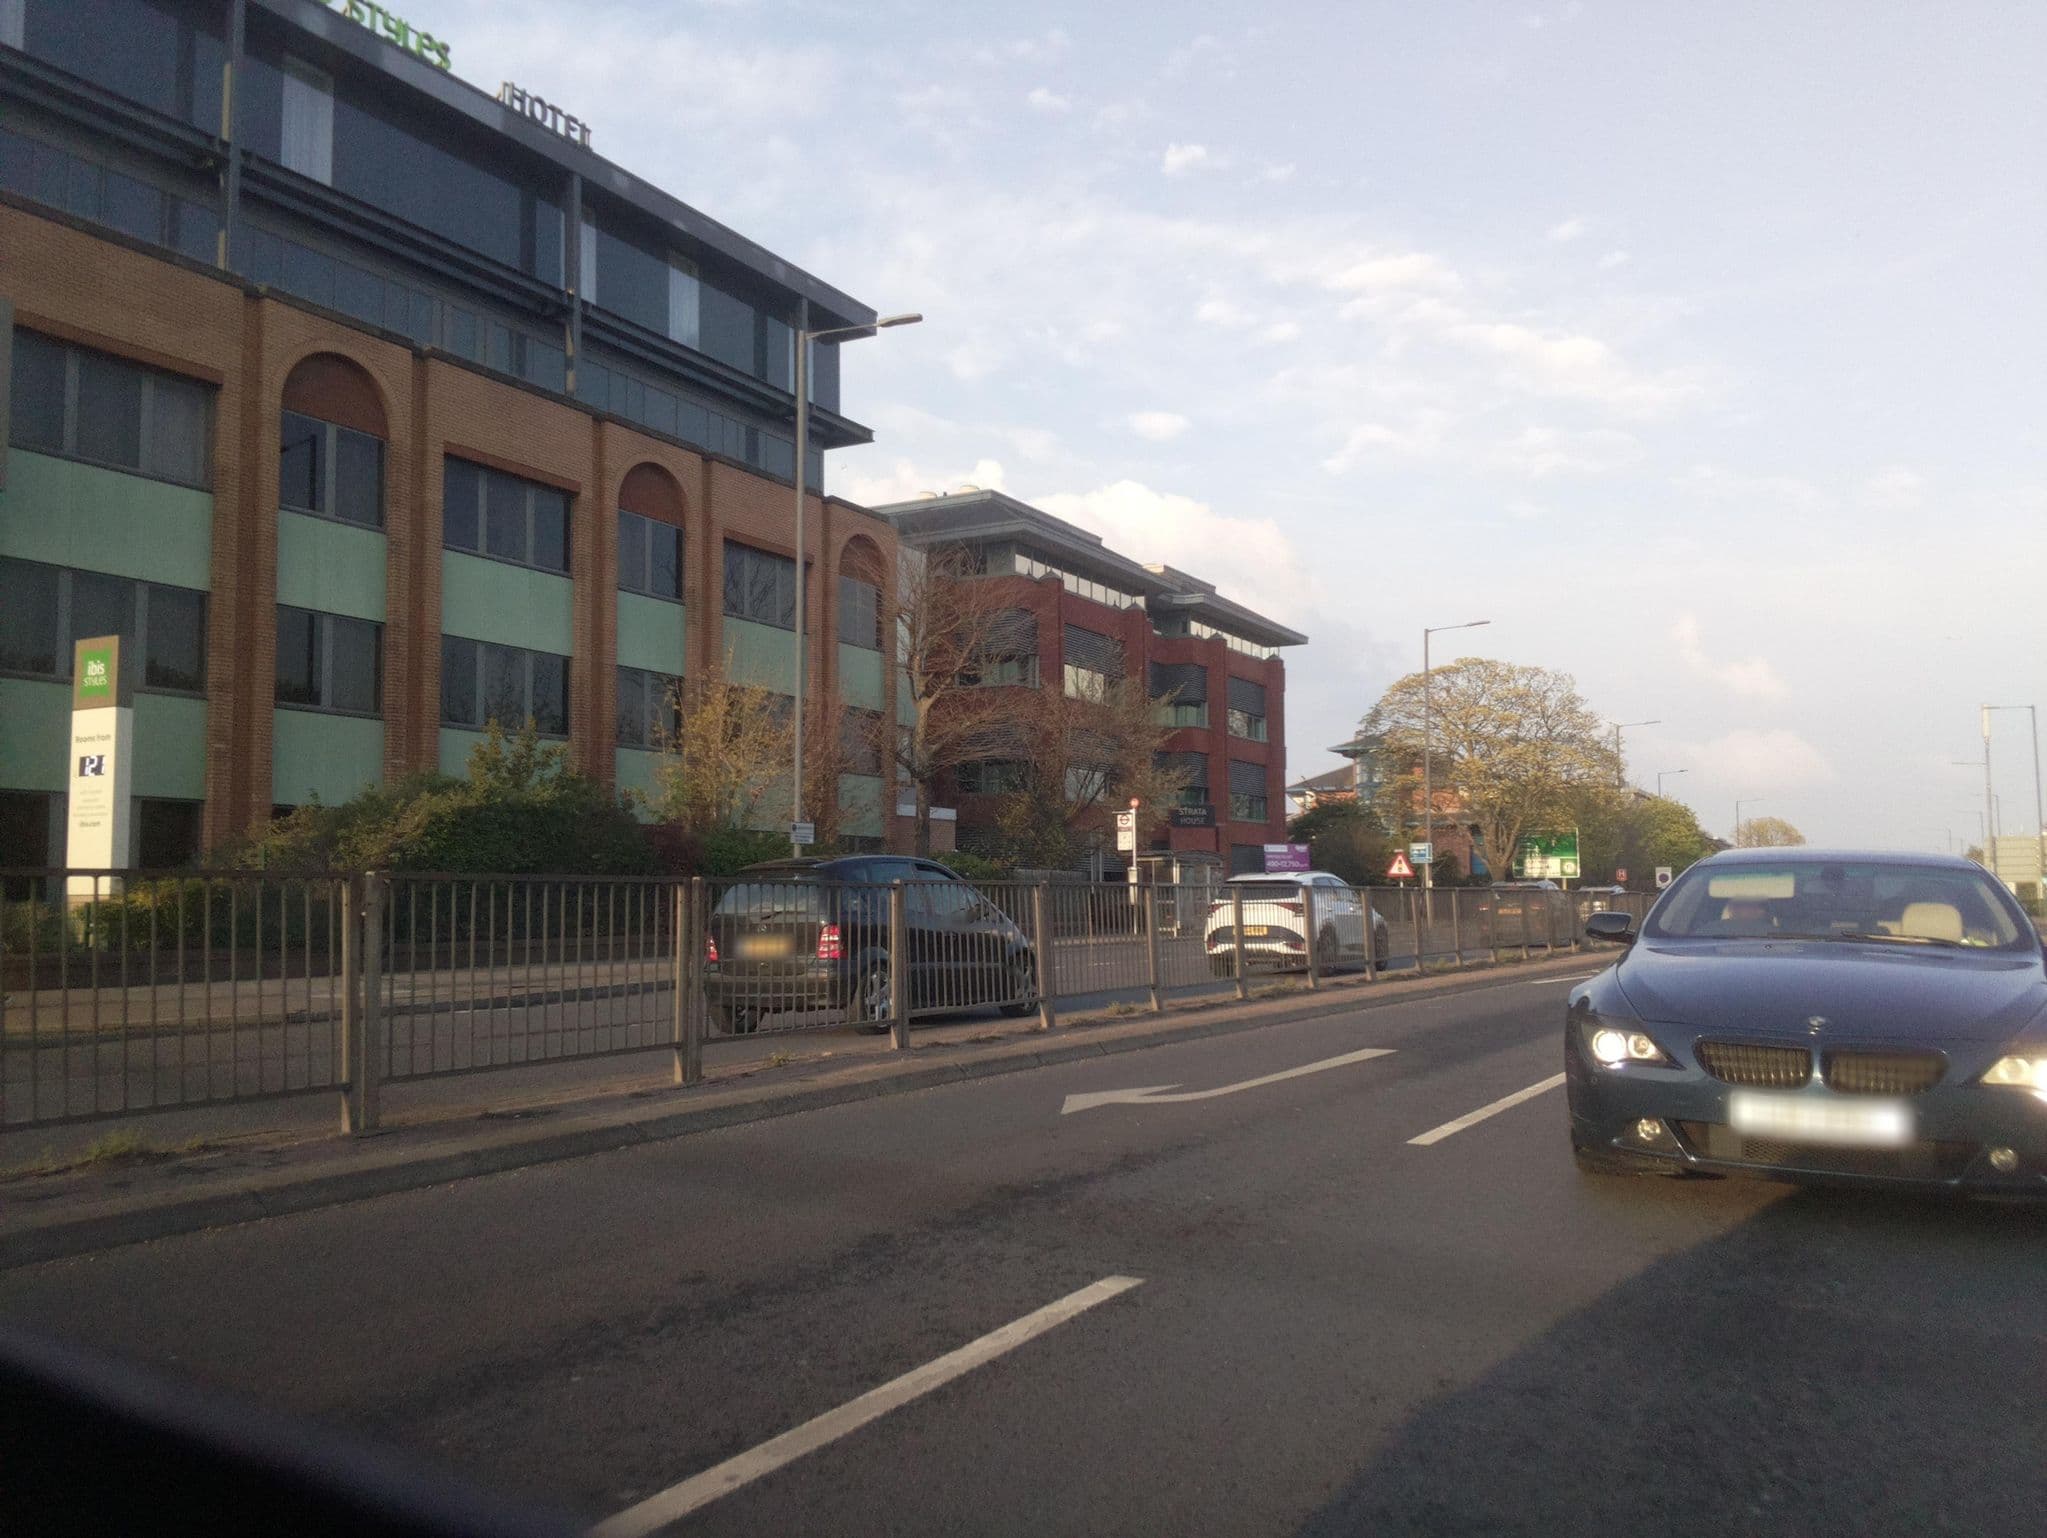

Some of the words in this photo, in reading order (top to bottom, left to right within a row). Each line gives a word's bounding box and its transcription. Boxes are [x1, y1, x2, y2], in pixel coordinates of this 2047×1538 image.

[508, 80, 591, 147] HOTEL
[87, 660, 105, 676] ibis
[75, 735, 96, 743] Rooms
[1177, 807, 1208, 817] STRATA
[1180, 817, 1206, 825] HOUSE
